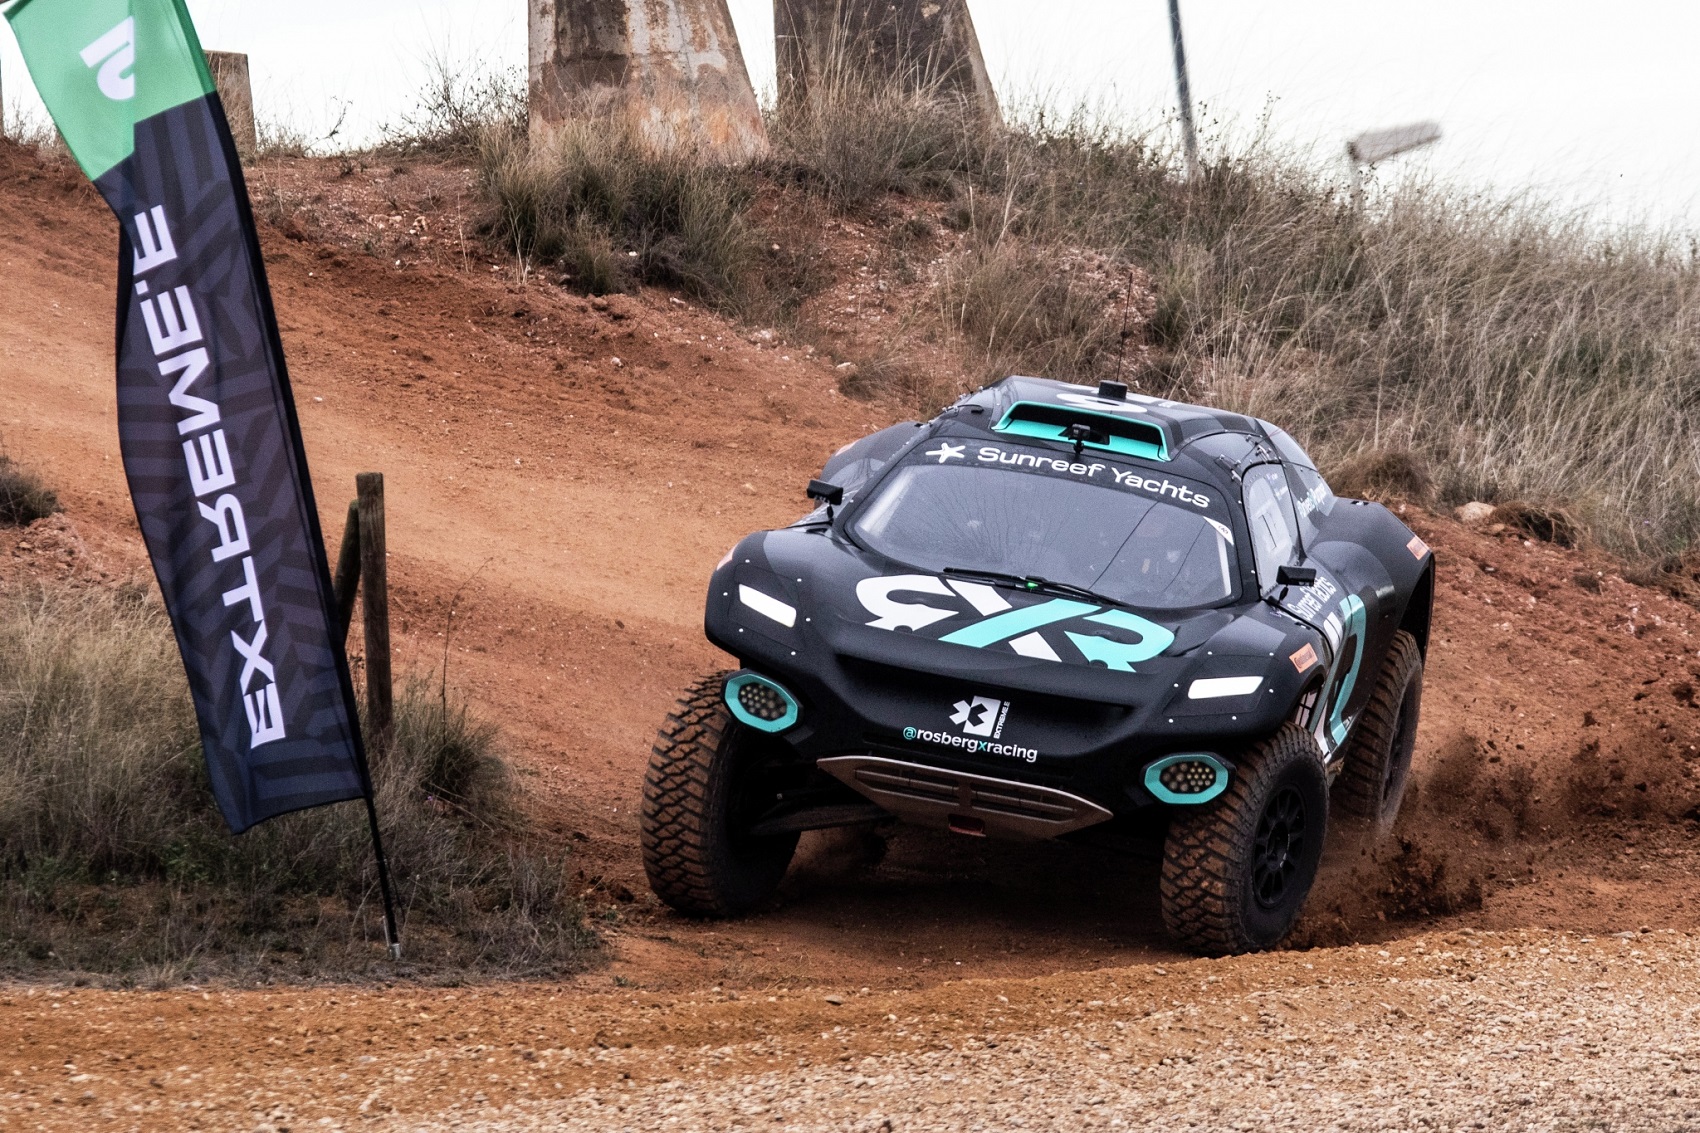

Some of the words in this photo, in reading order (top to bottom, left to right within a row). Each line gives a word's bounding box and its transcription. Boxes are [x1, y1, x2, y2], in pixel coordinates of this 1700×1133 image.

[977, 446, 1105, 478] Sunreef
[1111, 466, 1210, 508] Yachts
[903, 726, 1038, 763] @rosbergxracing
